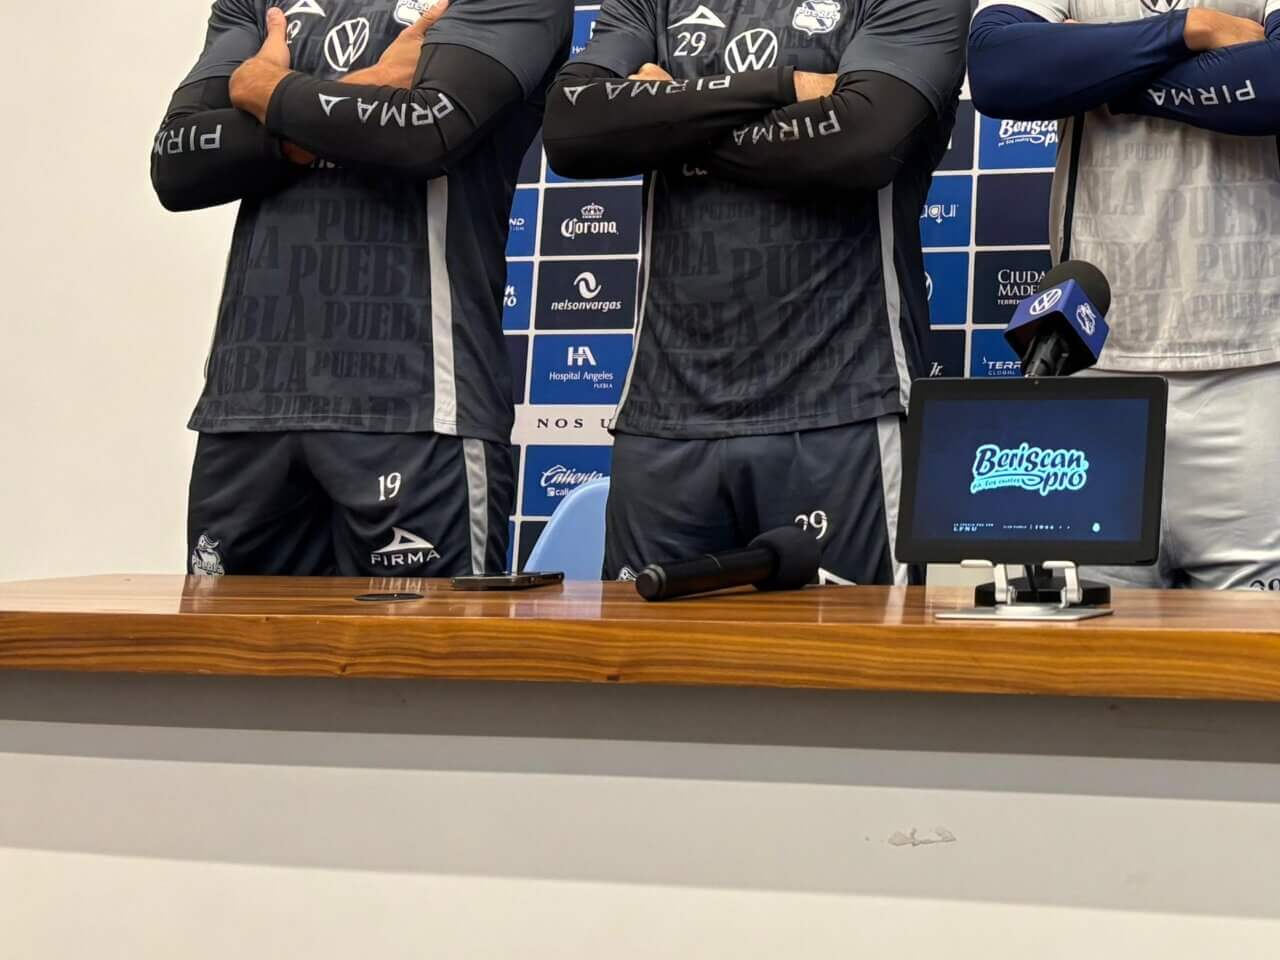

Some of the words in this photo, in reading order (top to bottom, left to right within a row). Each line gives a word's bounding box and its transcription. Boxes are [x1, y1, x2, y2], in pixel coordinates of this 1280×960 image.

[673, 31, 707, 57] 29
[604, 74, 732, 100] PIRMA
[1147, 79, 1256, 106] PIRMA
[732, 109, 842, 147] PIRMA
[998, 118, 1058, 139] Berisca
[560, 217, 618, 240] Corona
[997, 269, 1046, 284] CIUDA
[550, 299, 622, 312] nelsonvargas
[549, 372, 581, 382] Hospital
[583, 370, 614, 382] Angeles
[537, 418, 584, 429] NOS
[973, 442, 1090, 478] Beriscan
[377, 472, 402, 501] 19
[1040, 466, 1087, 497] pro
[371, 549, 440, 567] PIRMA
